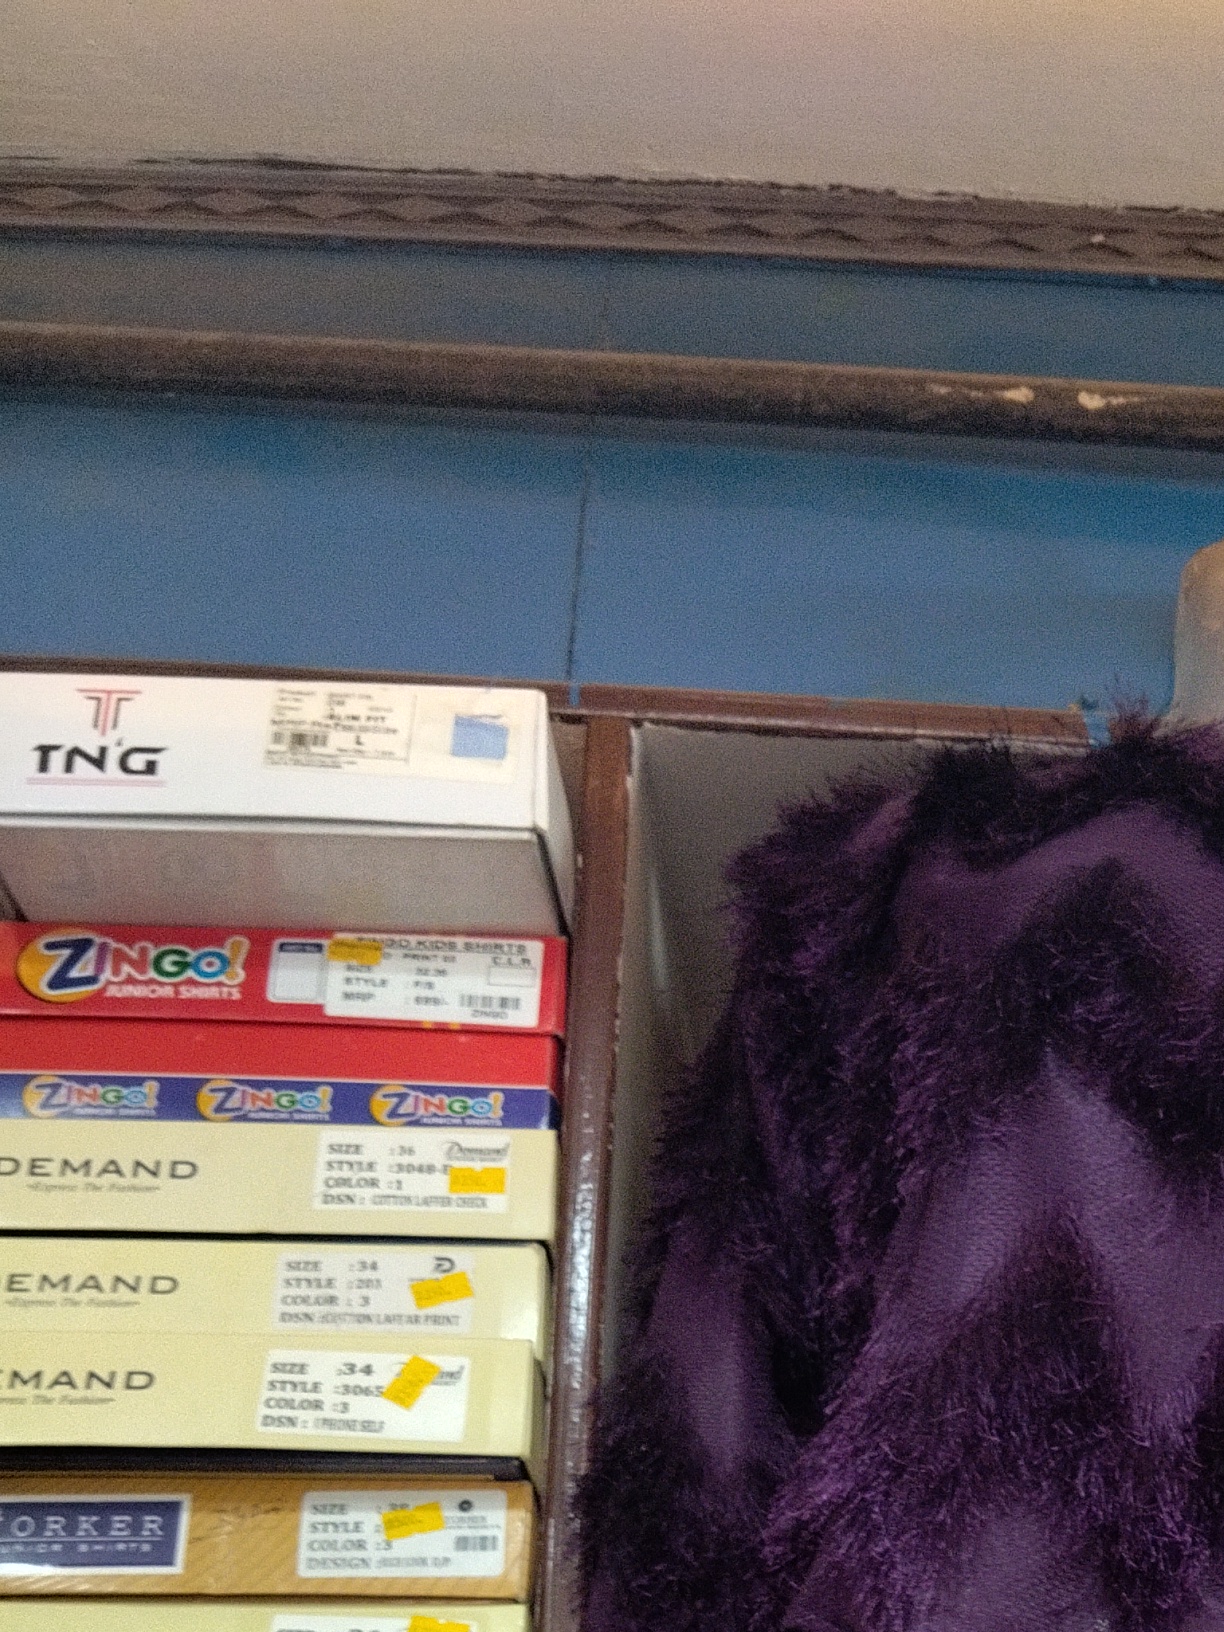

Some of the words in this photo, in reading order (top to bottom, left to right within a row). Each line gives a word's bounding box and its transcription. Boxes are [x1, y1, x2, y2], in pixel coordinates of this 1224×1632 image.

[327, 1144, 363, 1155] SIZE
[0, 1157, 199, 1180] DEMAND
[325, 1161, 377, 1173] STYLE
[324, 1177, 380, 1189] COLOR
[286, 1260, 323, 1272] SIZE
[283, 1278, 337, 1290] STYLE
[281, 1295, 340, 1307] COLOR
[270, 1362, 309, 1375] SIZE
[0, 1370, 156, 1391] MAND
[267, 1380, 323, 1394] STYLE
[264, 1398, 325, 1412] COLOR
[311, 1503, 348, 1515] SIZE
[0, 1515, 164, 1537] ORKER
[310, 1521, 364, 1534] STYLE
[307, 1539, 367, 1552] COLOR
